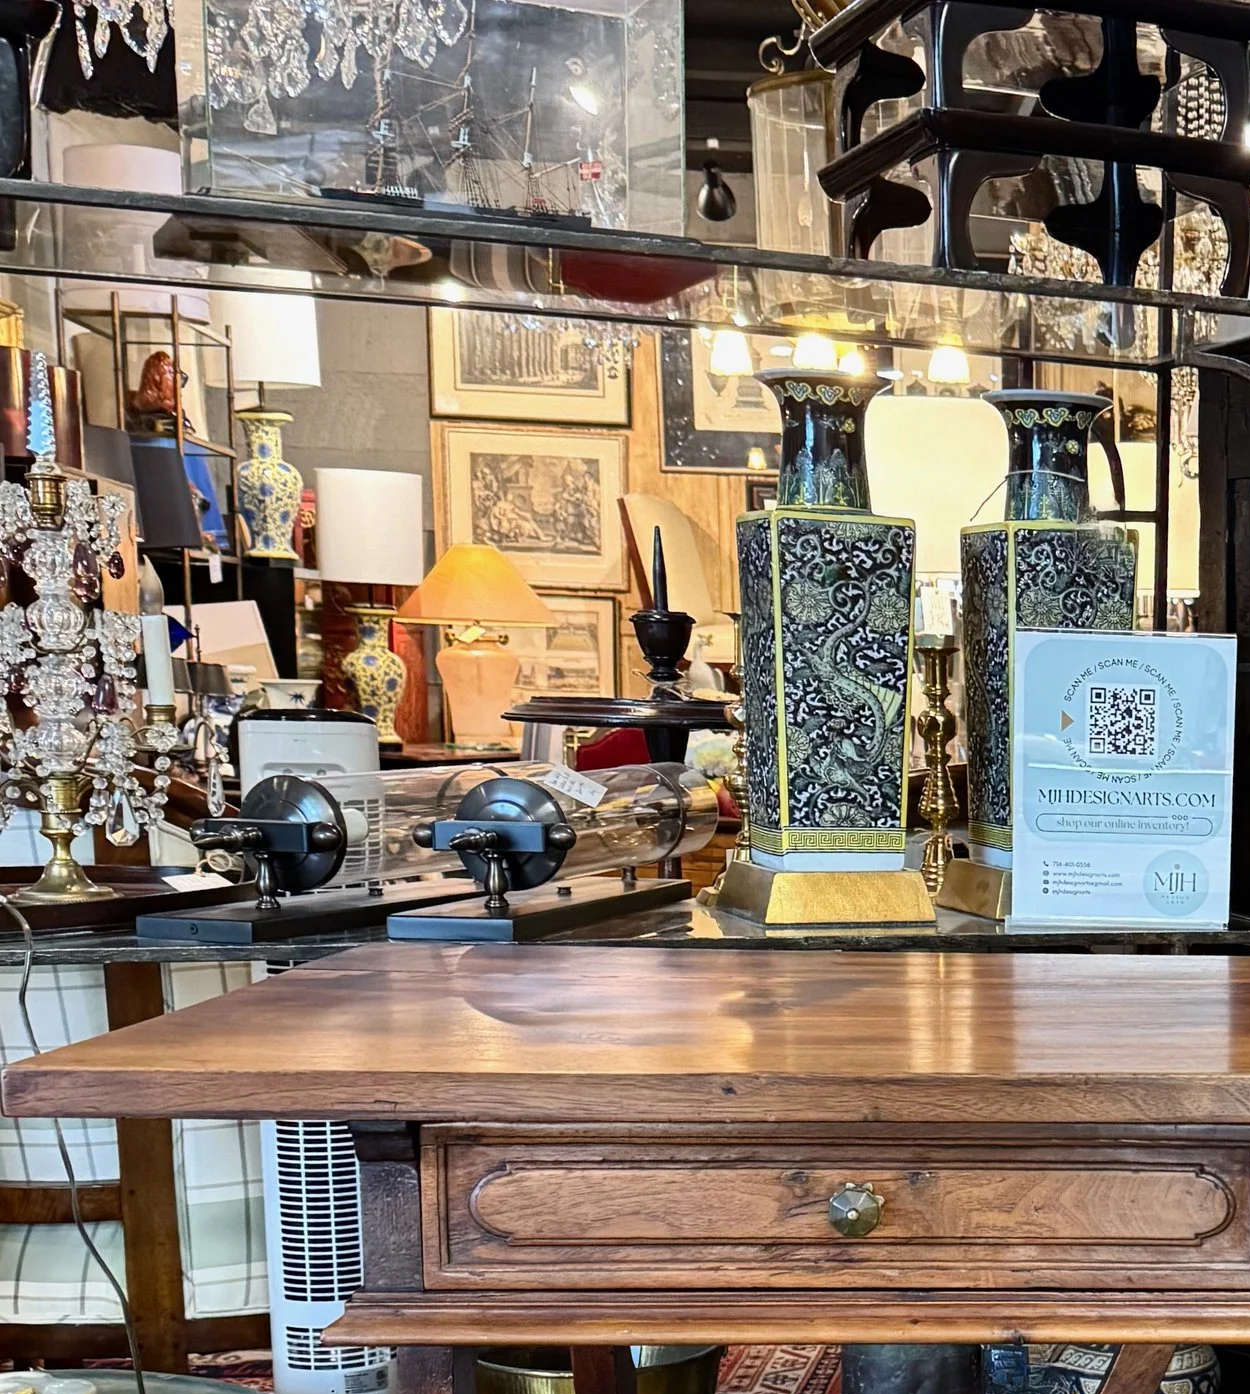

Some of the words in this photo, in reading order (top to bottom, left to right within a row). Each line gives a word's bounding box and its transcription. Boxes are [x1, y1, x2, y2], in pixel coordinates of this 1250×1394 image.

[1098, 658, 1124, 670] SCAN
[1126, 659, 1139, 669] ME
[1080, 668, 1094, 680] ME
[1144, 664, 1168, 685] SCAN
[1064, 678, 1082, 702] SCAN
[1165, 683, 1177, 697] ME
[1172, 702, 1183, 729] SCAN
[1172, 730, 1183, 744] ME
[1062, 738, 1074, 751] ME
[1154, 748, 1176, 771] SCAN
[1096, 771, 1110, 782] ME
[1112, 775, 1137, 784] SCAN
[1038, 788, 1216, 808] MJHDESIGNARTS.COM
[1056, 818, 1082, 830] shop
[1084, 820, 1102, 828] our
[1104, 819, 1136, 829] online
[1154, 872, 1196, 894] MJH
